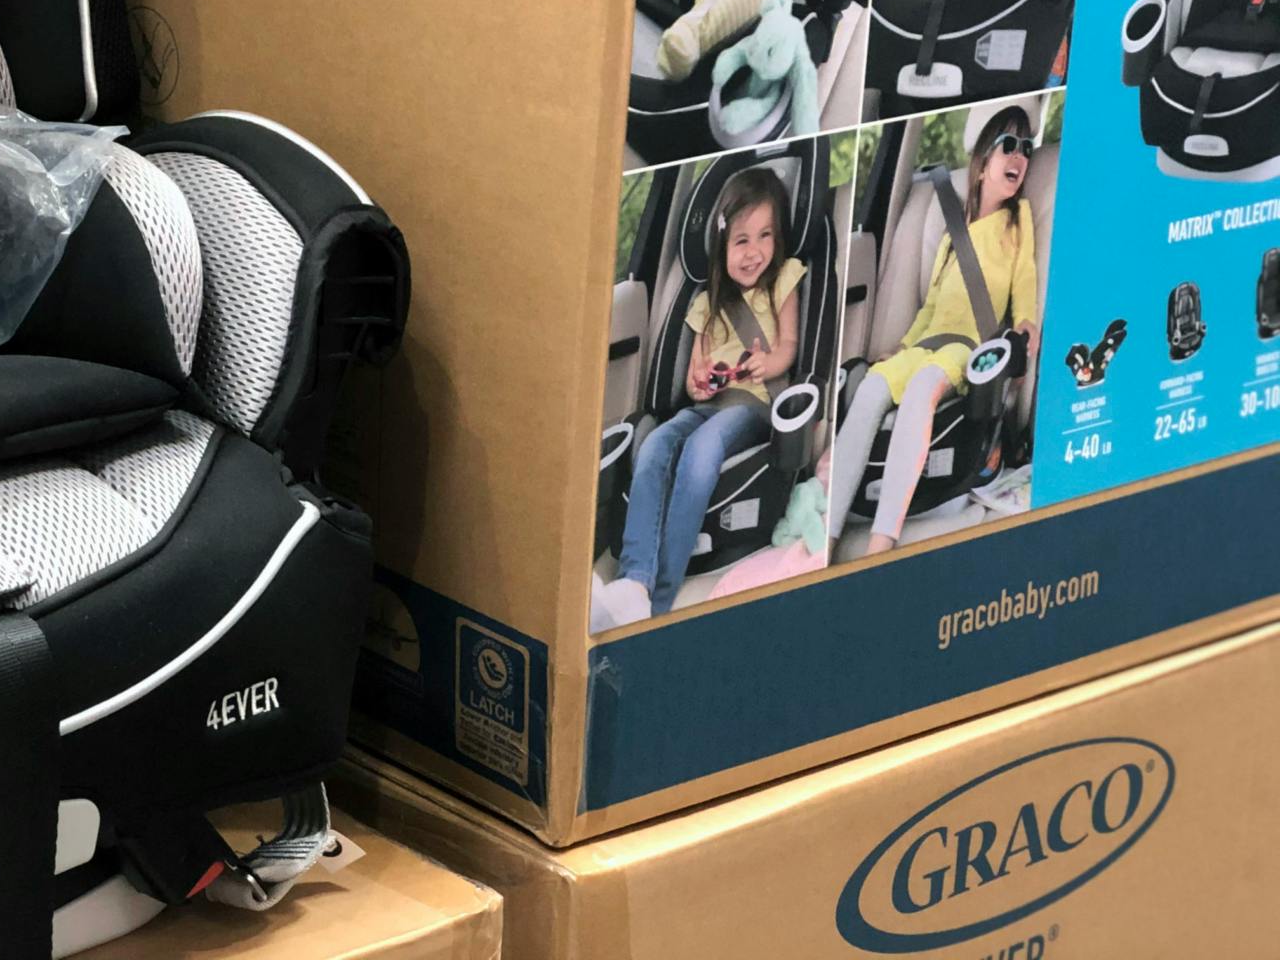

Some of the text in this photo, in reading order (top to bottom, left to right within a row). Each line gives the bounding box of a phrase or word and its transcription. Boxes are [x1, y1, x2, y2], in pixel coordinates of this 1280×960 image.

[1223, 198, 1280, 231] COLLECTI
[1239, 384, 1280, 417] 30-10
[1154, 407, 1196, 441] 22-65
[1065, 433, 1100, 465] 4-40
[938, 570, 1099, 650] gracobaby.com
[206, 677, 280, 730] 4EVER
[470, 691, 515, 725] LATCH
